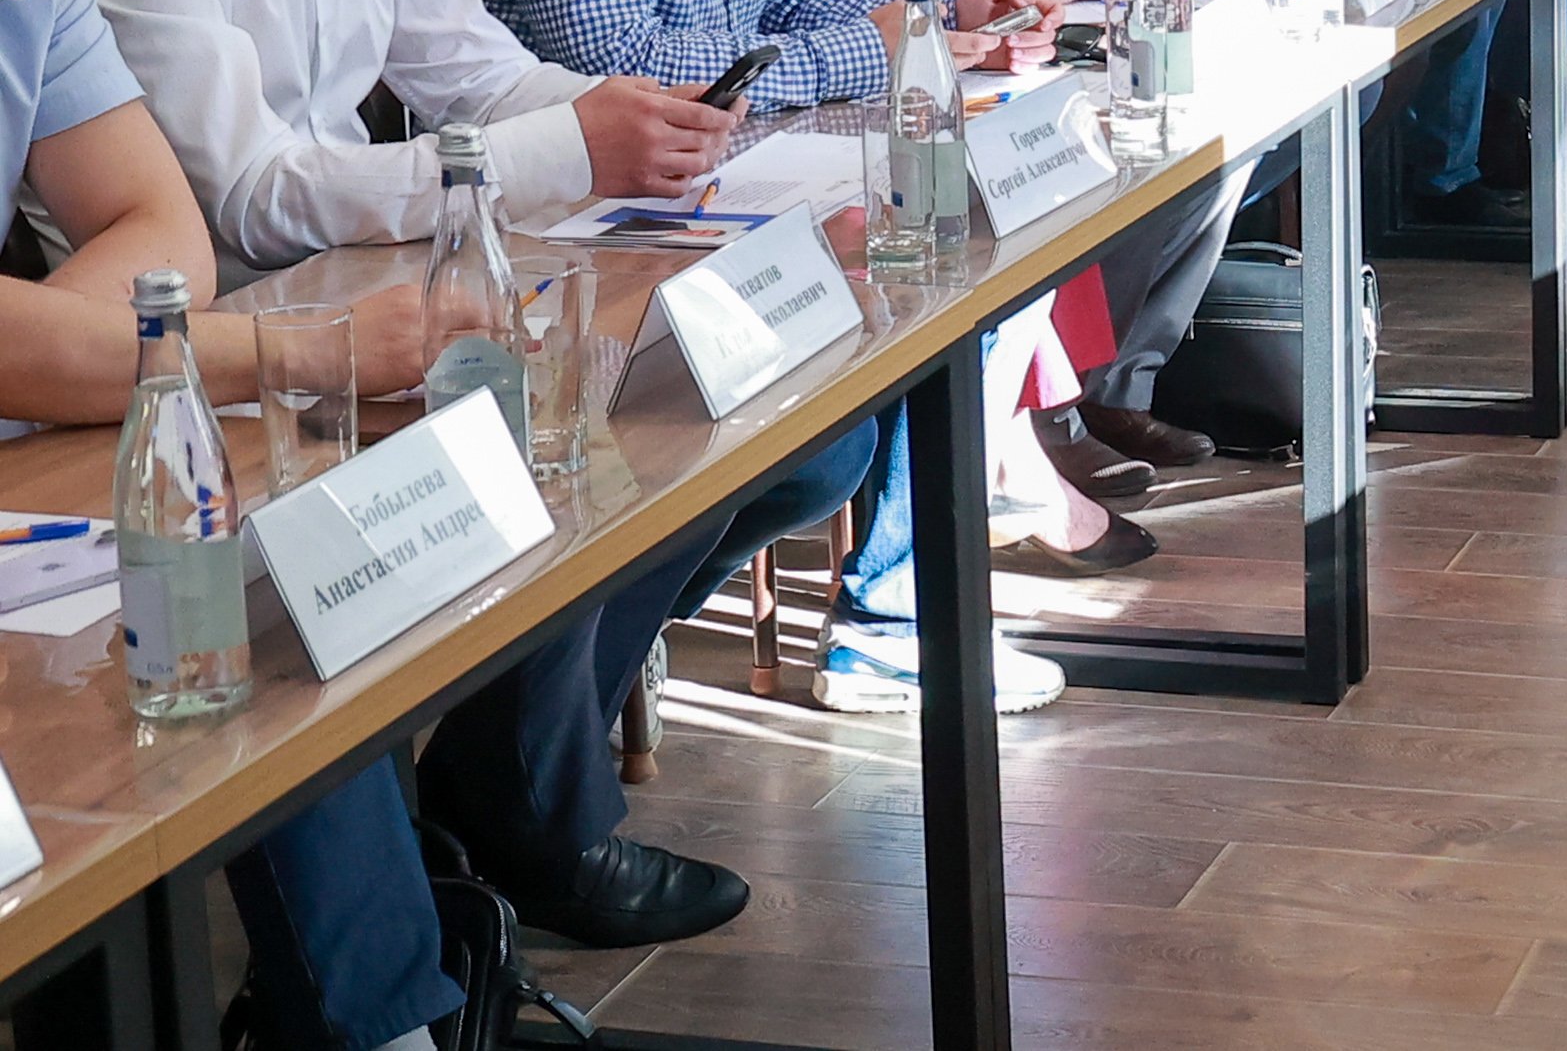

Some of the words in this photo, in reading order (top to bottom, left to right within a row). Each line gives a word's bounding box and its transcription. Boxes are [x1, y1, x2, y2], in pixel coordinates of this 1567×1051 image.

[1009, 122, 1057, 152] Горячев
[987, 166, 1027, 200] Сергей
[761, 280, 828, 330] иколаевич
[348, 468, 447, 538] Бобылева
[312, 538, 419, 616] Анастасия
[419, 500, 486, 552] Андрее
